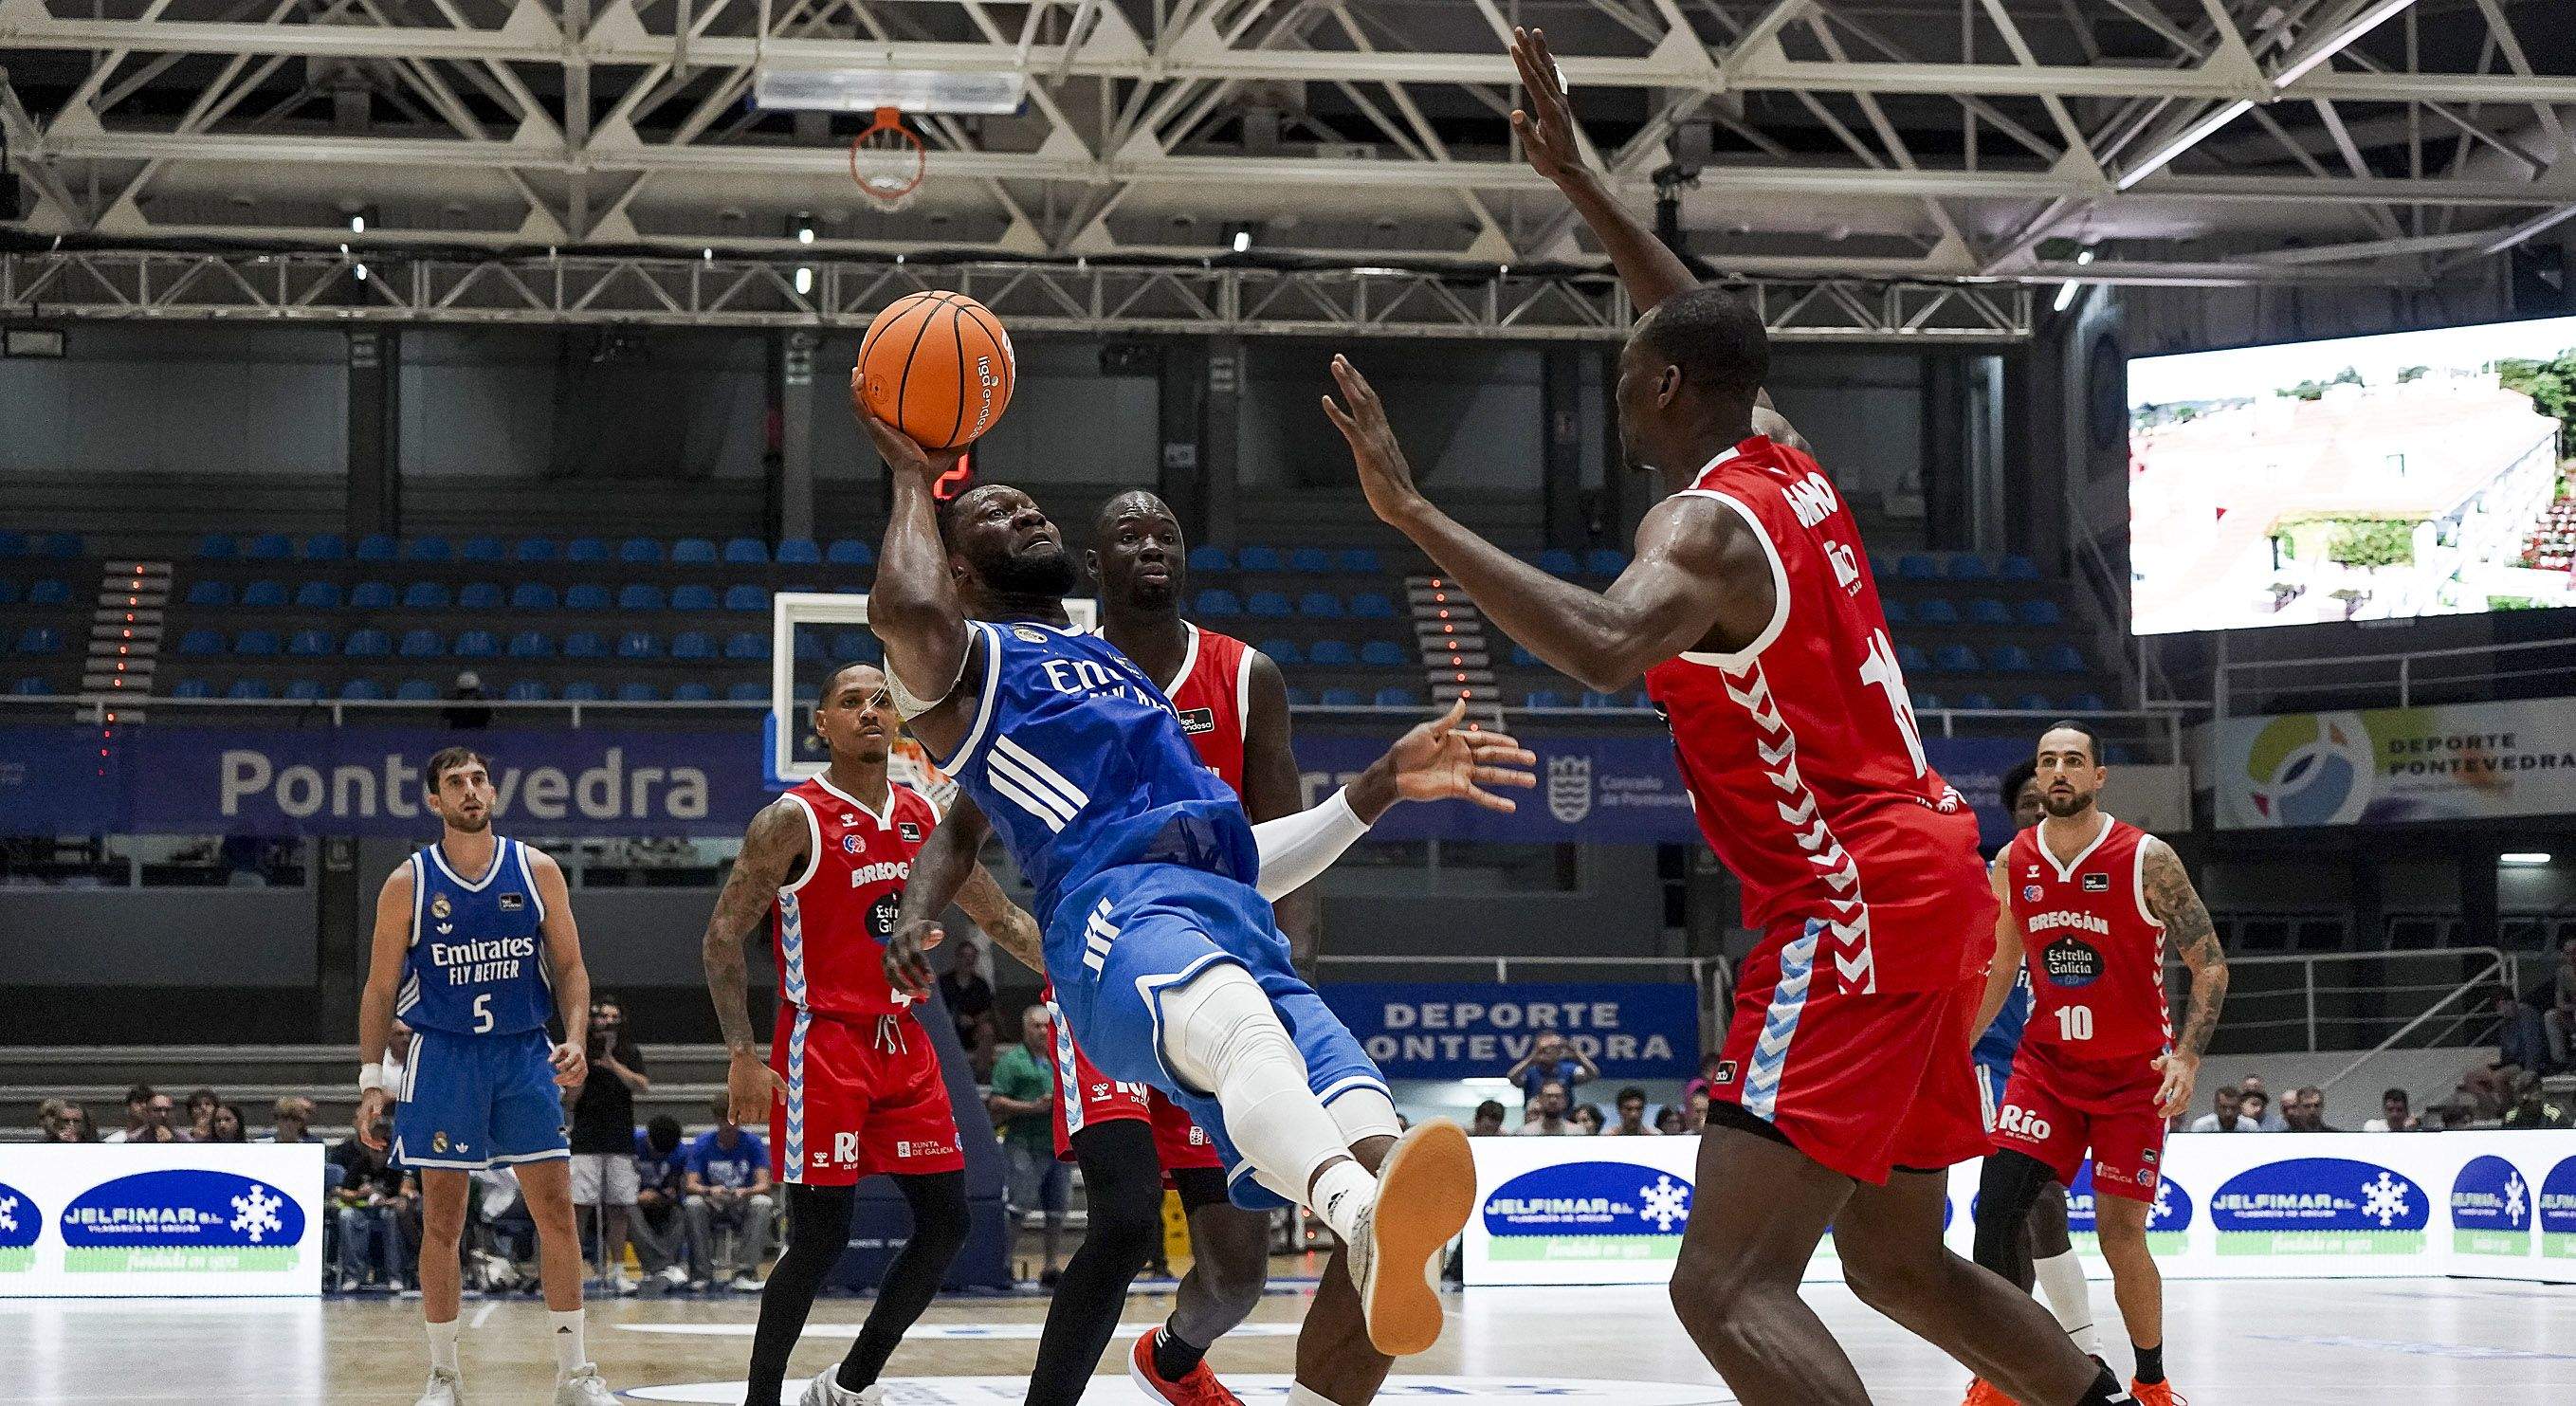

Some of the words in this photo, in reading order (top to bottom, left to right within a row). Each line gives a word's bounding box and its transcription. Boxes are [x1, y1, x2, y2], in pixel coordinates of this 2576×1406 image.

[2388, 732, 2515, 754] DEPORTE
[2389, 752, 2576, 775] PONTEVEDRA
[220, 749, 709, 819] Pontvedra
[852, 862, 915, 887] BREOG
[2029, 910, 2110, 935] BREOGÁN
[431, 937, 534, 967] Emirates
[2048, 950, 2092, 961] Estrella
[449, 966, 471, 986] FLY
[474, 959, 519, 983] BETTER
[2049, 961, 2092, 974] Galicia
[473, 994, 494, 1034] 5
[1383, 1002, 1620, 1030] DEPORTE
[2055, 1005, 2094, 1041] 10
[1365, 1033, 1674, 1062] ONTEVDRA
[1999, 1105, 2051, 1139] Río
[924, 1146, 954, 1156] GALICIA
